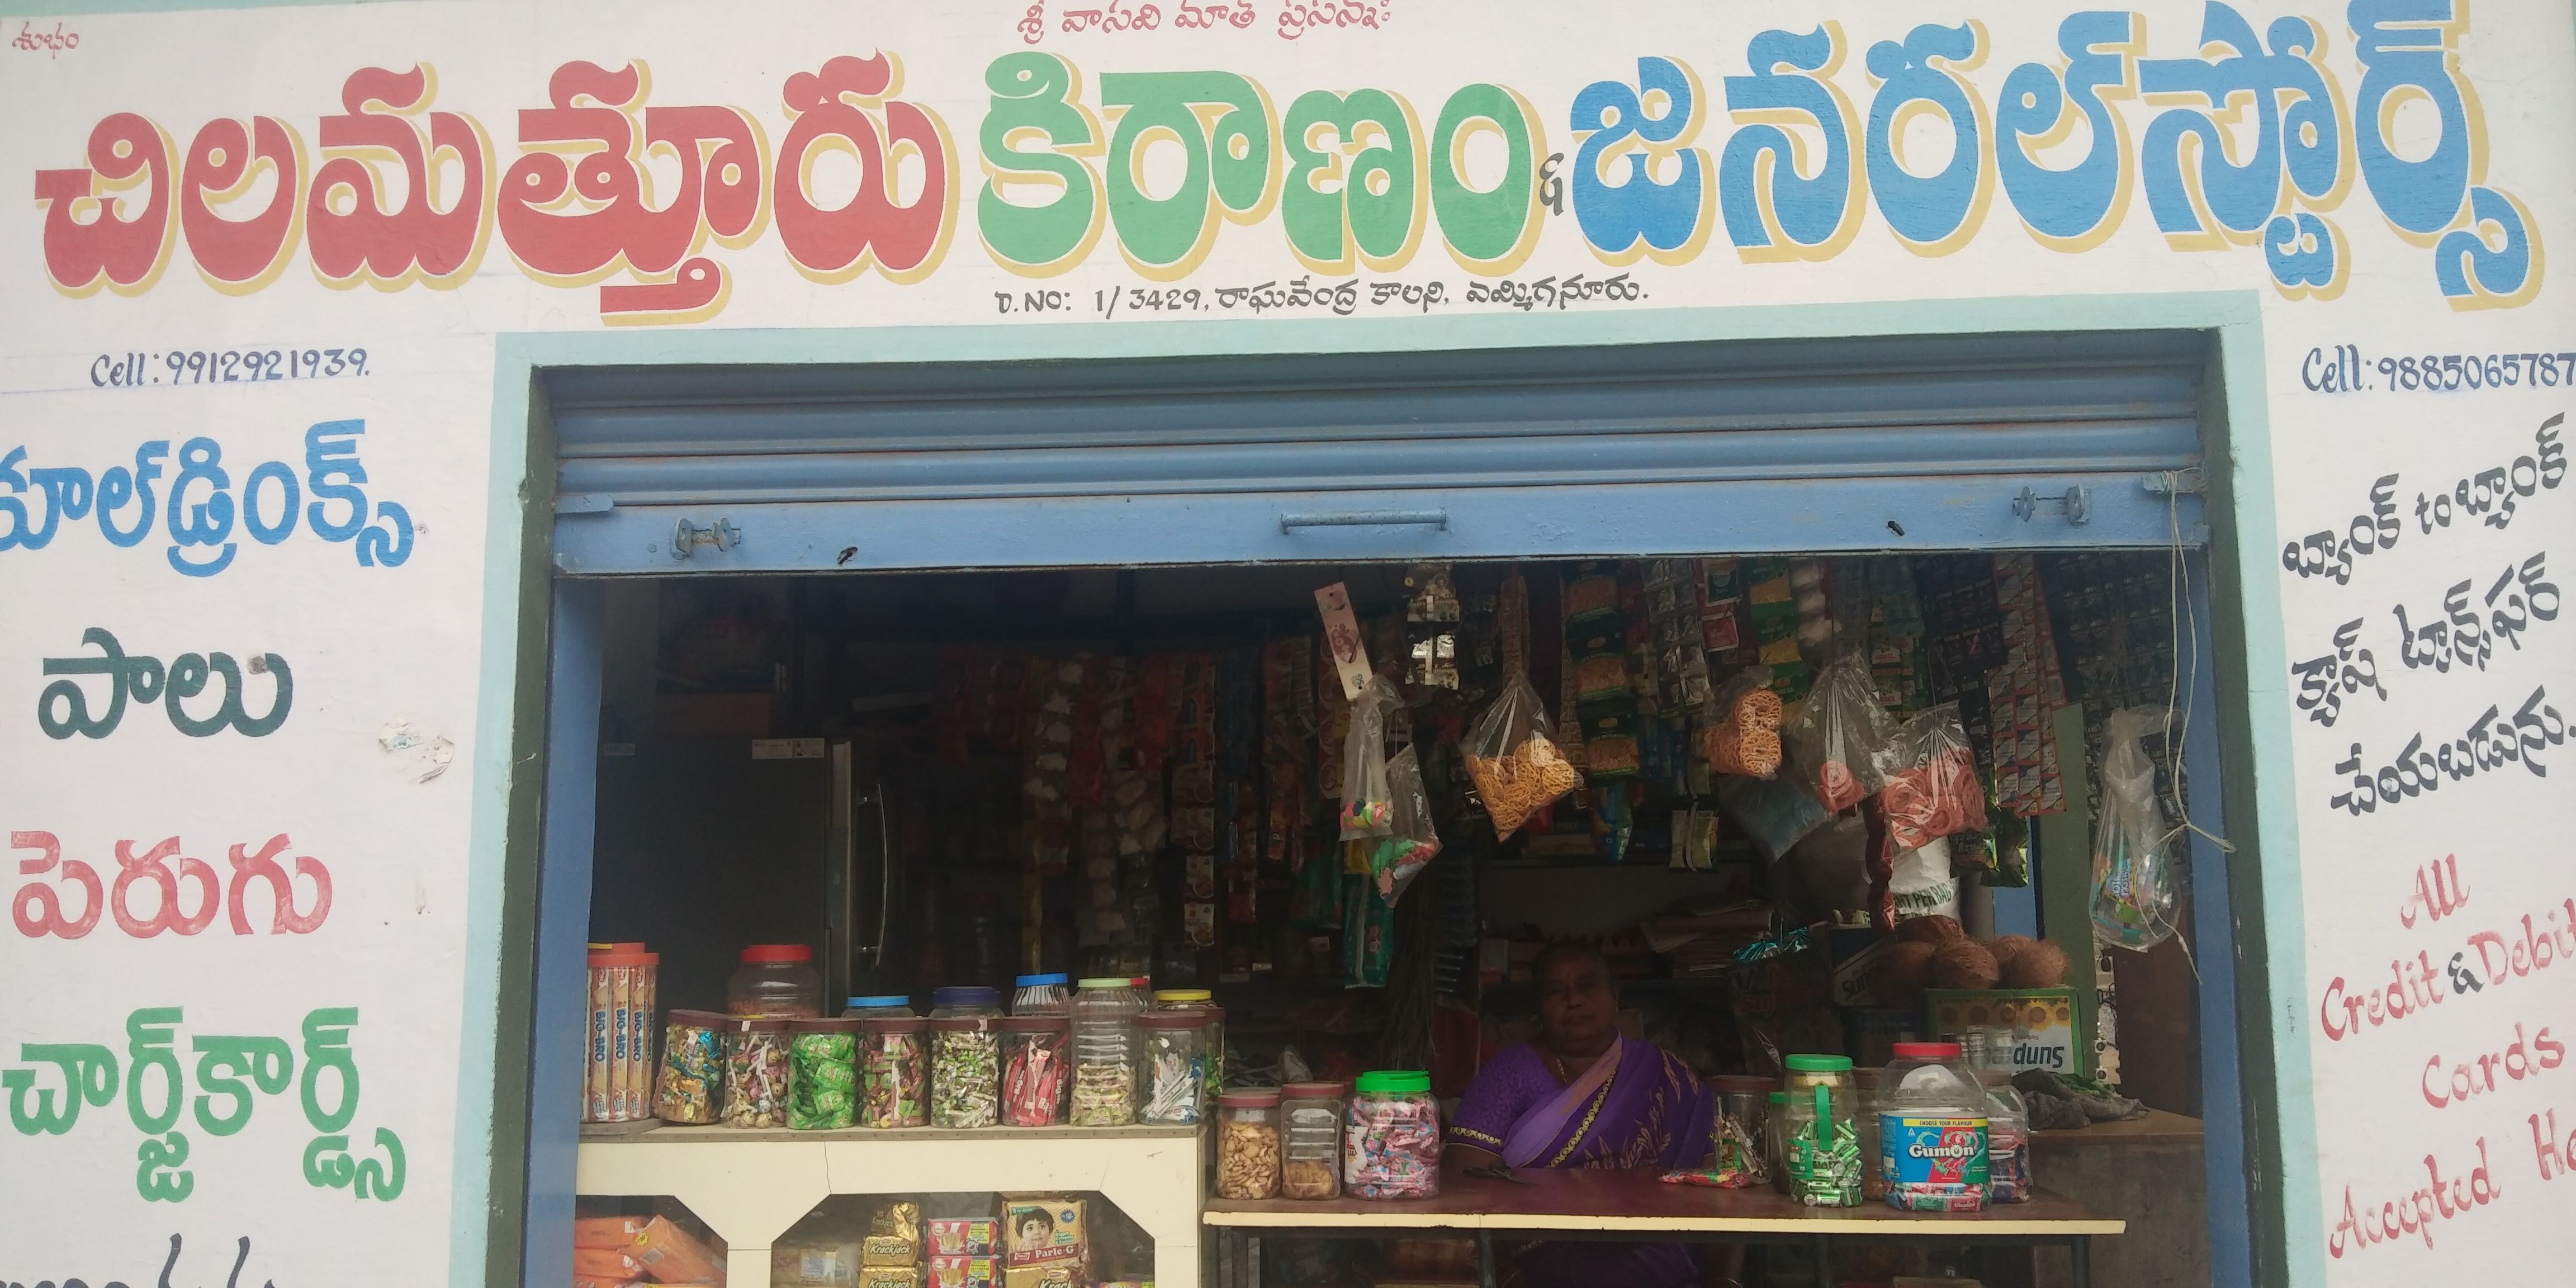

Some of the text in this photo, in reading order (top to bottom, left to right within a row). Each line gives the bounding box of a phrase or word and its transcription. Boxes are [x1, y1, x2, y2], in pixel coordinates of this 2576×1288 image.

[1062, 0, 1162, 32] వాసవి
[35, 48, 959, 325] చిలమత్తూరు
[977, 51, 1549, 280] కిరాణం
[2415, 492, 2451, 534] to
[38, 627, 293, 739] పాలు
[11, 831, 332, 940] పెరుగు
[2400, 853, 2470, 929] All
[2321, 949, 2445, 1041] Credit
[2467, 898, 2576, 985] Debit
[2422, 1021, 2565, 1109] Cards
[2329, 1136, 2501, 1258] Accepted
[869, 1243, 911, 1257] Krackjack
[1035, 1246, 1074, 1258] Parle-G
